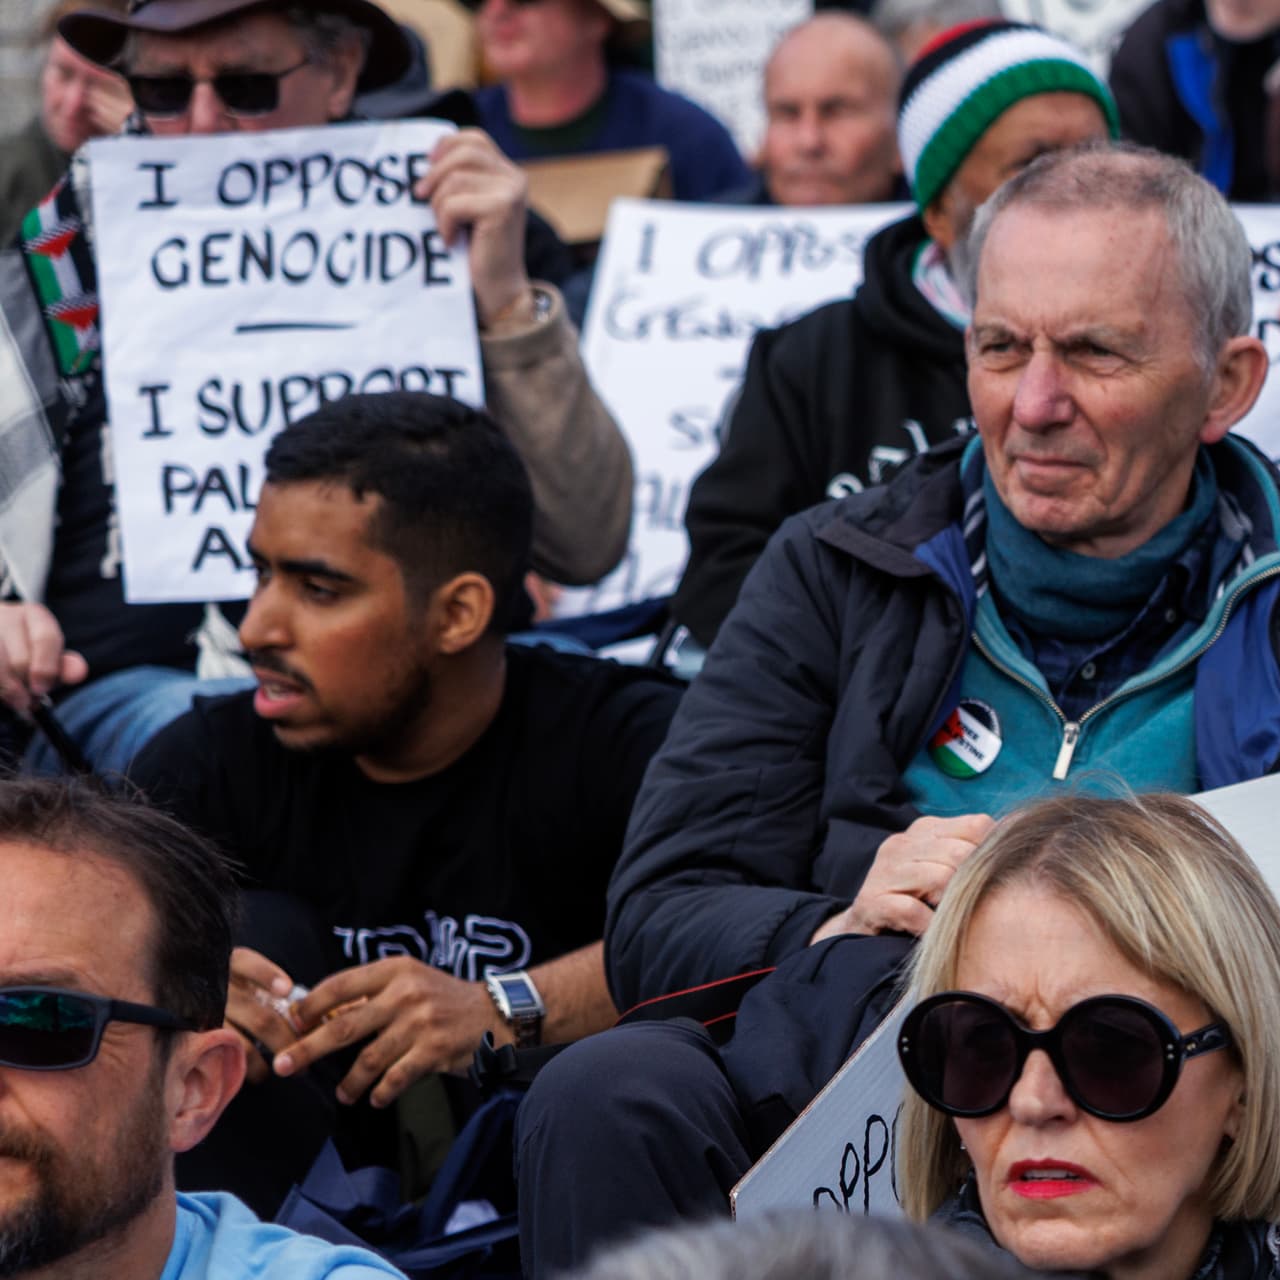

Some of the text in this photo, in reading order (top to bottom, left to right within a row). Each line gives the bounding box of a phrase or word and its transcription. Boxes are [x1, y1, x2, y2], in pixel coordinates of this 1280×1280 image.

[138, 152, 431, 210] I OPPOSE
[151, 226, 453, 289] GENOCIDE
[139, 382, 172, 440] I
